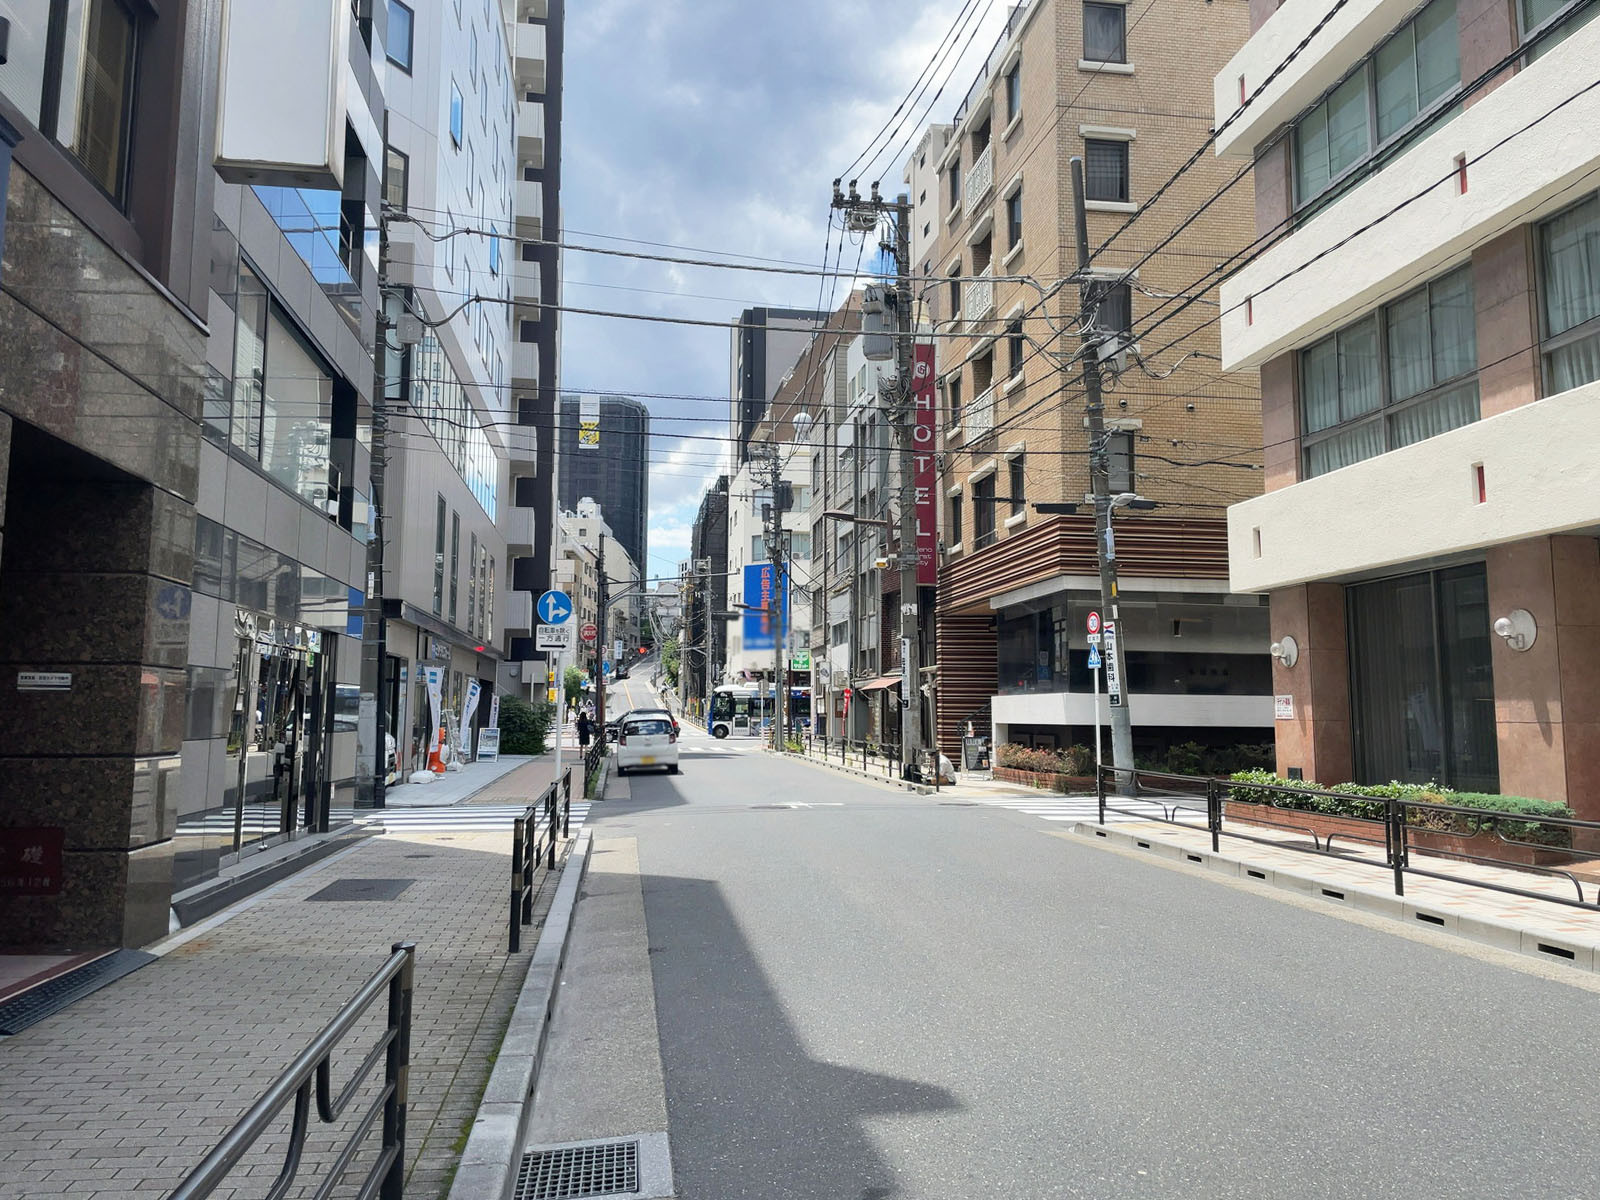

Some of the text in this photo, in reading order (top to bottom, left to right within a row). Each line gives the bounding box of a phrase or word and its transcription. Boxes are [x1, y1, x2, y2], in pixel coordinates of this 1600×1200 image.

[913, 394, 931, 537] HOTEL
[761, 567, 770, 633] 広告主
[538, 627, 571, 635] 自転車を除く
[538, 635, 570, 643] 一方通行
[1106, 643, 1115, 682] 山本歯科
